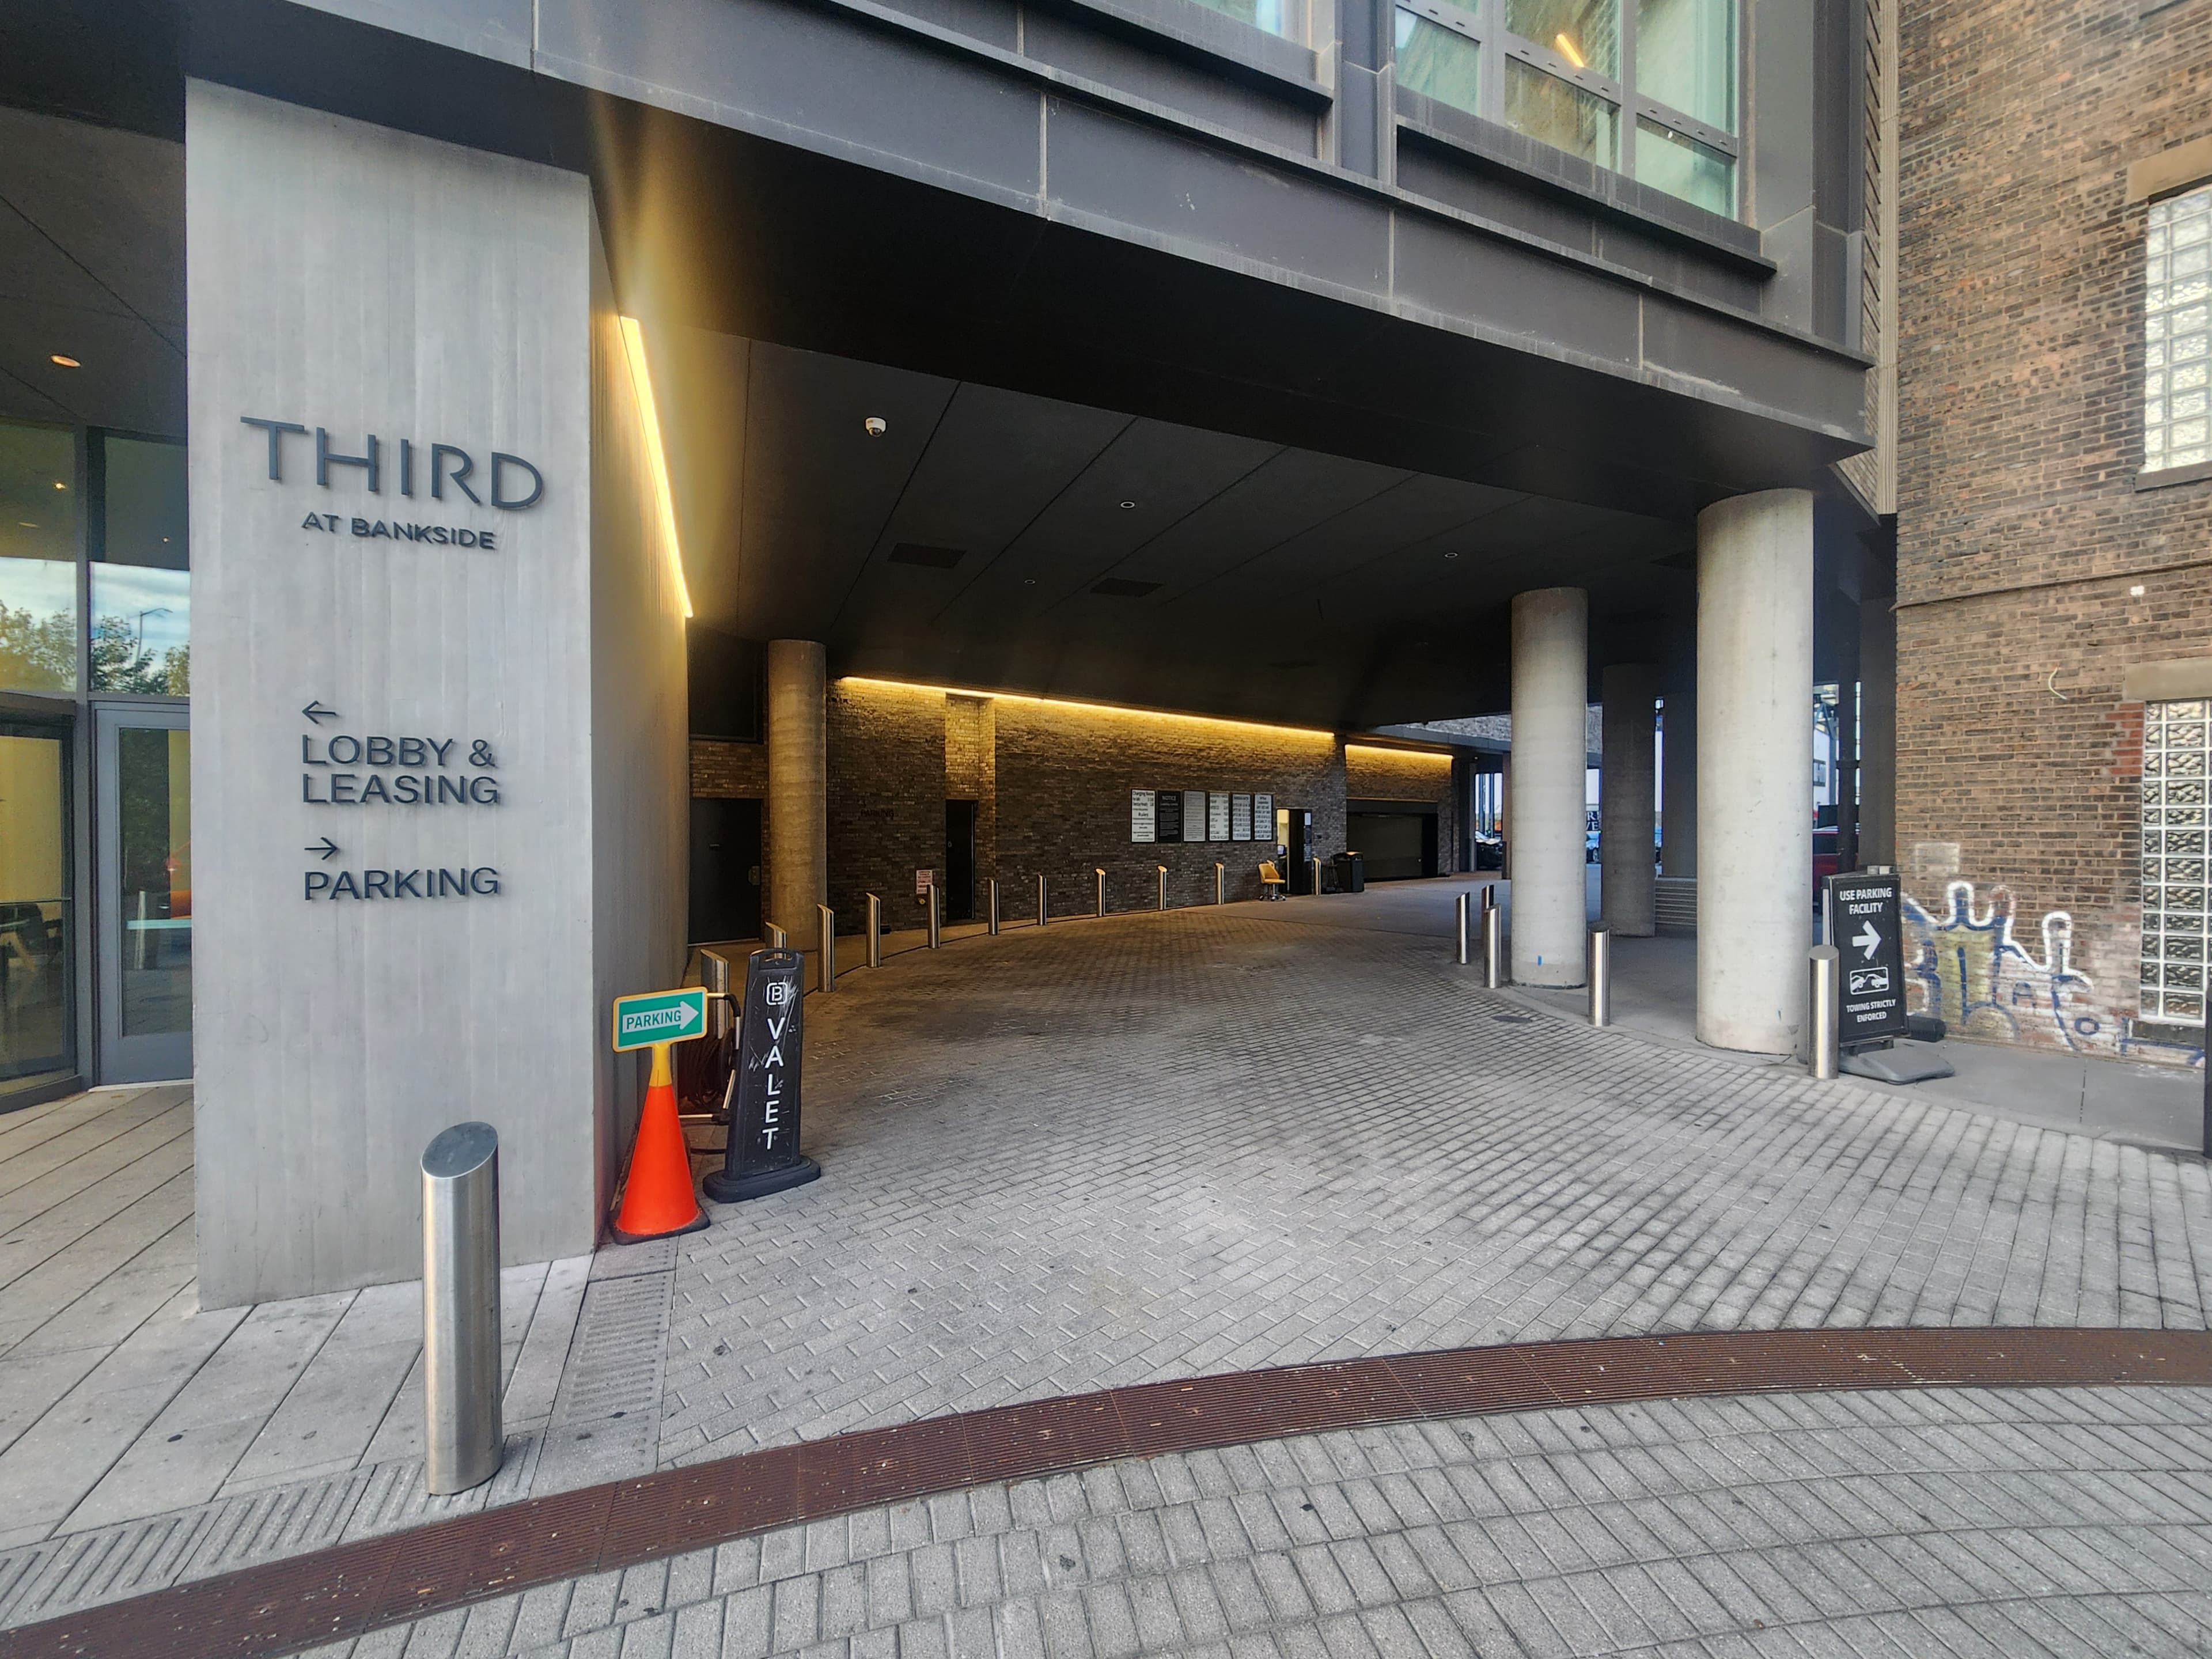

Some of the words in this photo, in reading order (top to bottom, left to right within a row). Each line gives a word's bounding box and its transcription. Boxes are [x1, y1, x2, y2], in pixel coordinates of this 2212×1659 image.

[240, 416, 543, 508] THIRD
[301, 512, 339, 532] AT
[351, 517, 495, 550] BANKSIDE
[302, 734, 453, 766] LOBBY
[468, 738, 495, 767] &
[302, 773, 498, 804] LEASING
[304, 866, 498, 900] PARKING
[1839, 889, 1855, 901] USE
[1856, 888, 1892, 900] PARKING
[1849, 902, 1883, 915] FACILITY
[626, 1010, 681, 1029] PARKING
[1846, 1002, 1870, 1013] TOWING
[1870, 999, 1896, 1009] STRICTLY
[1857, 1012, 1887, 1022] ENFORCED
[762, 1017, 785, 1150] VALET
